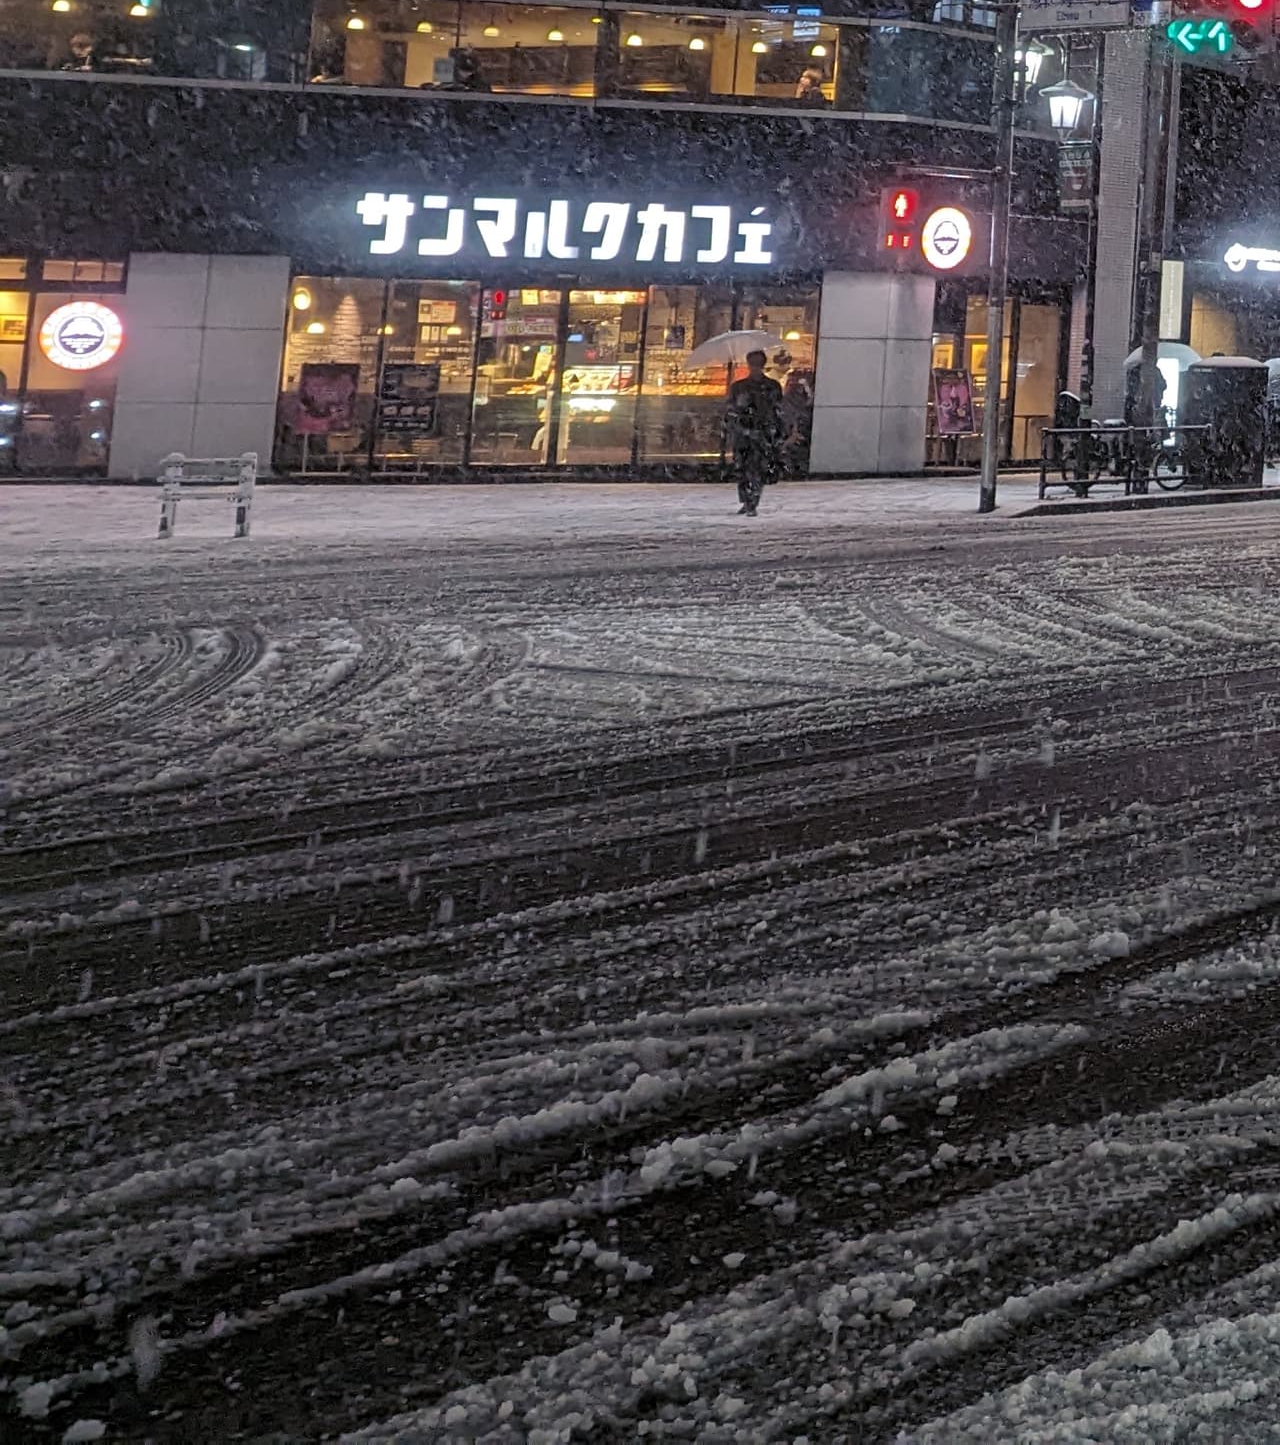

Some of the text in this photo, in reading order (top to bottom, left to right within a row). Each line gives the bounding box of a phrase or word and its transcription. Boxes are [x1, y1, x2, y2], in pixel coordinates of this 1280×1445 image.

[356, 192, 772, 265] サンマルクカフェ
